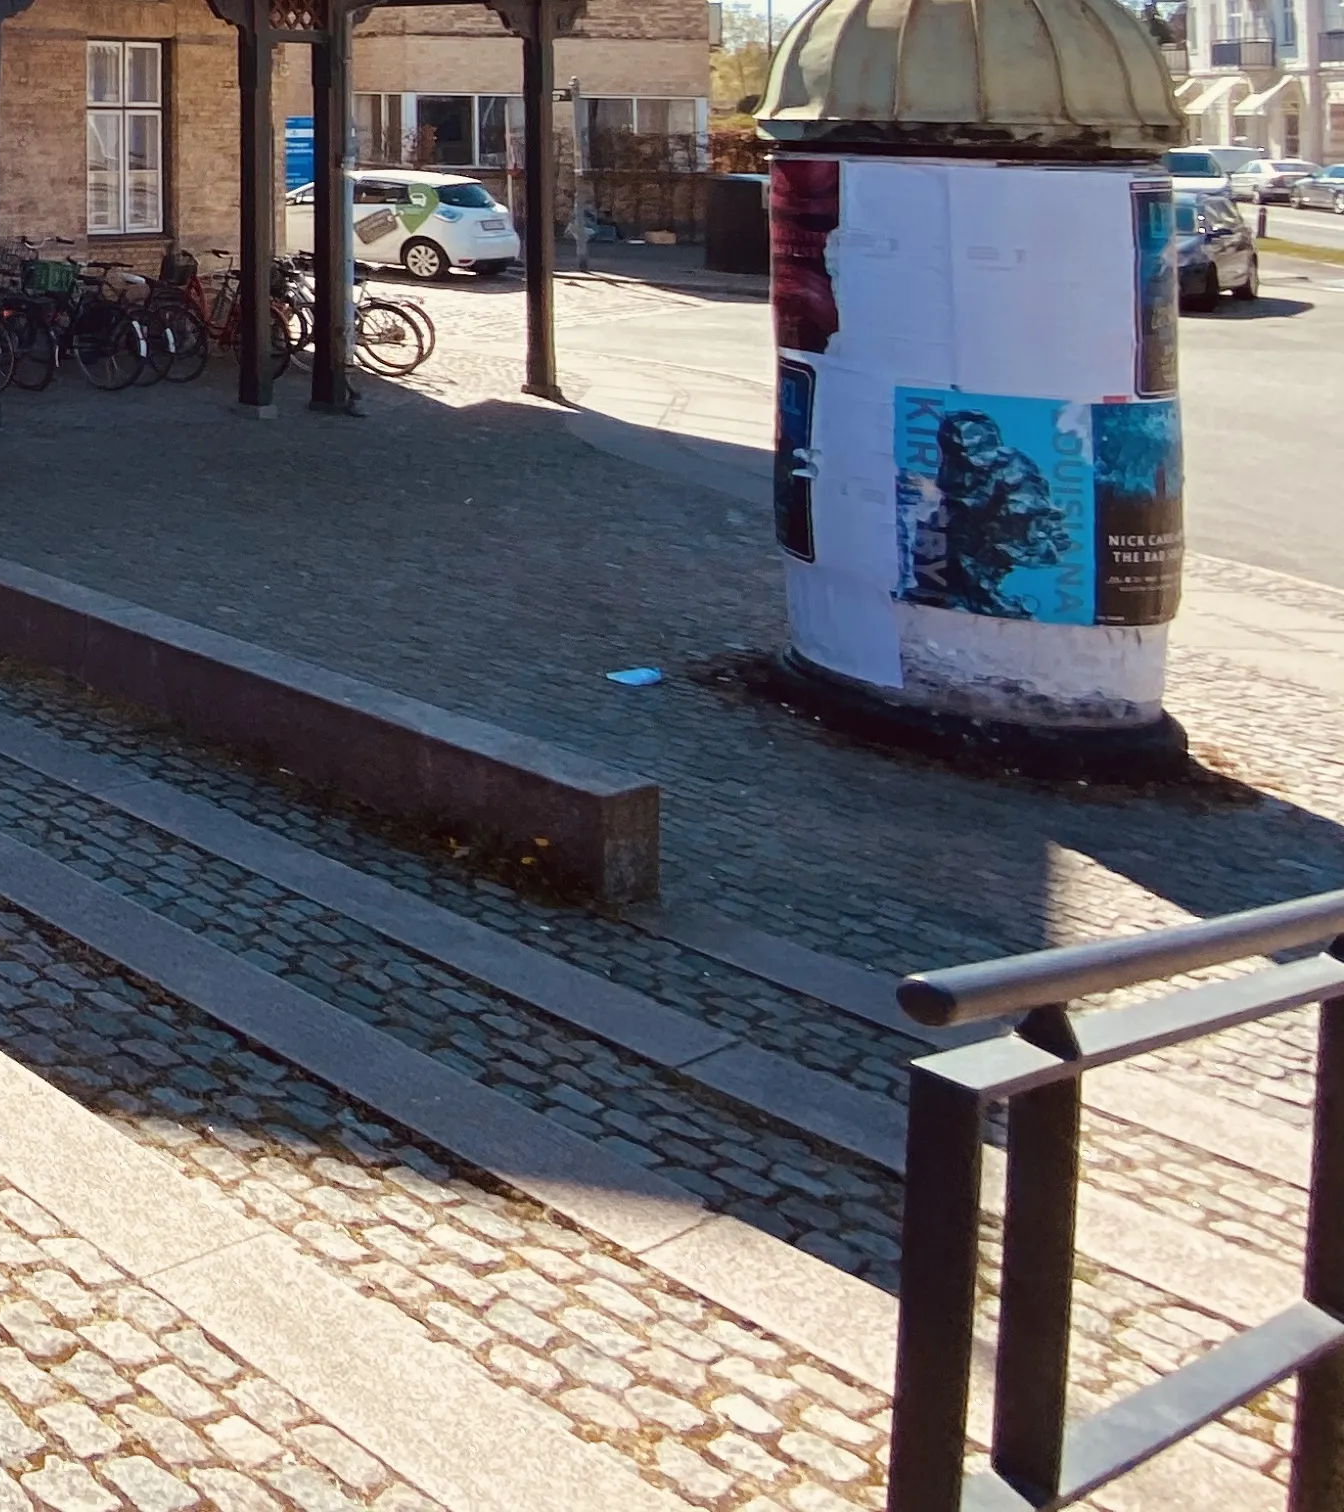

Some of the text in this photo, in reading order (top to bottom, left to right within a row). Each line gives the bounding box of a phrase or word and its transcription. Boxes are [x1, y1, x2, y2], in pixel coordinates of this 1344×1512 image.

[905, 395, 949, 587] KIRBY
[1108, 534, 1145, 547] NICK
[1112, 551, 1140, 563] THE
